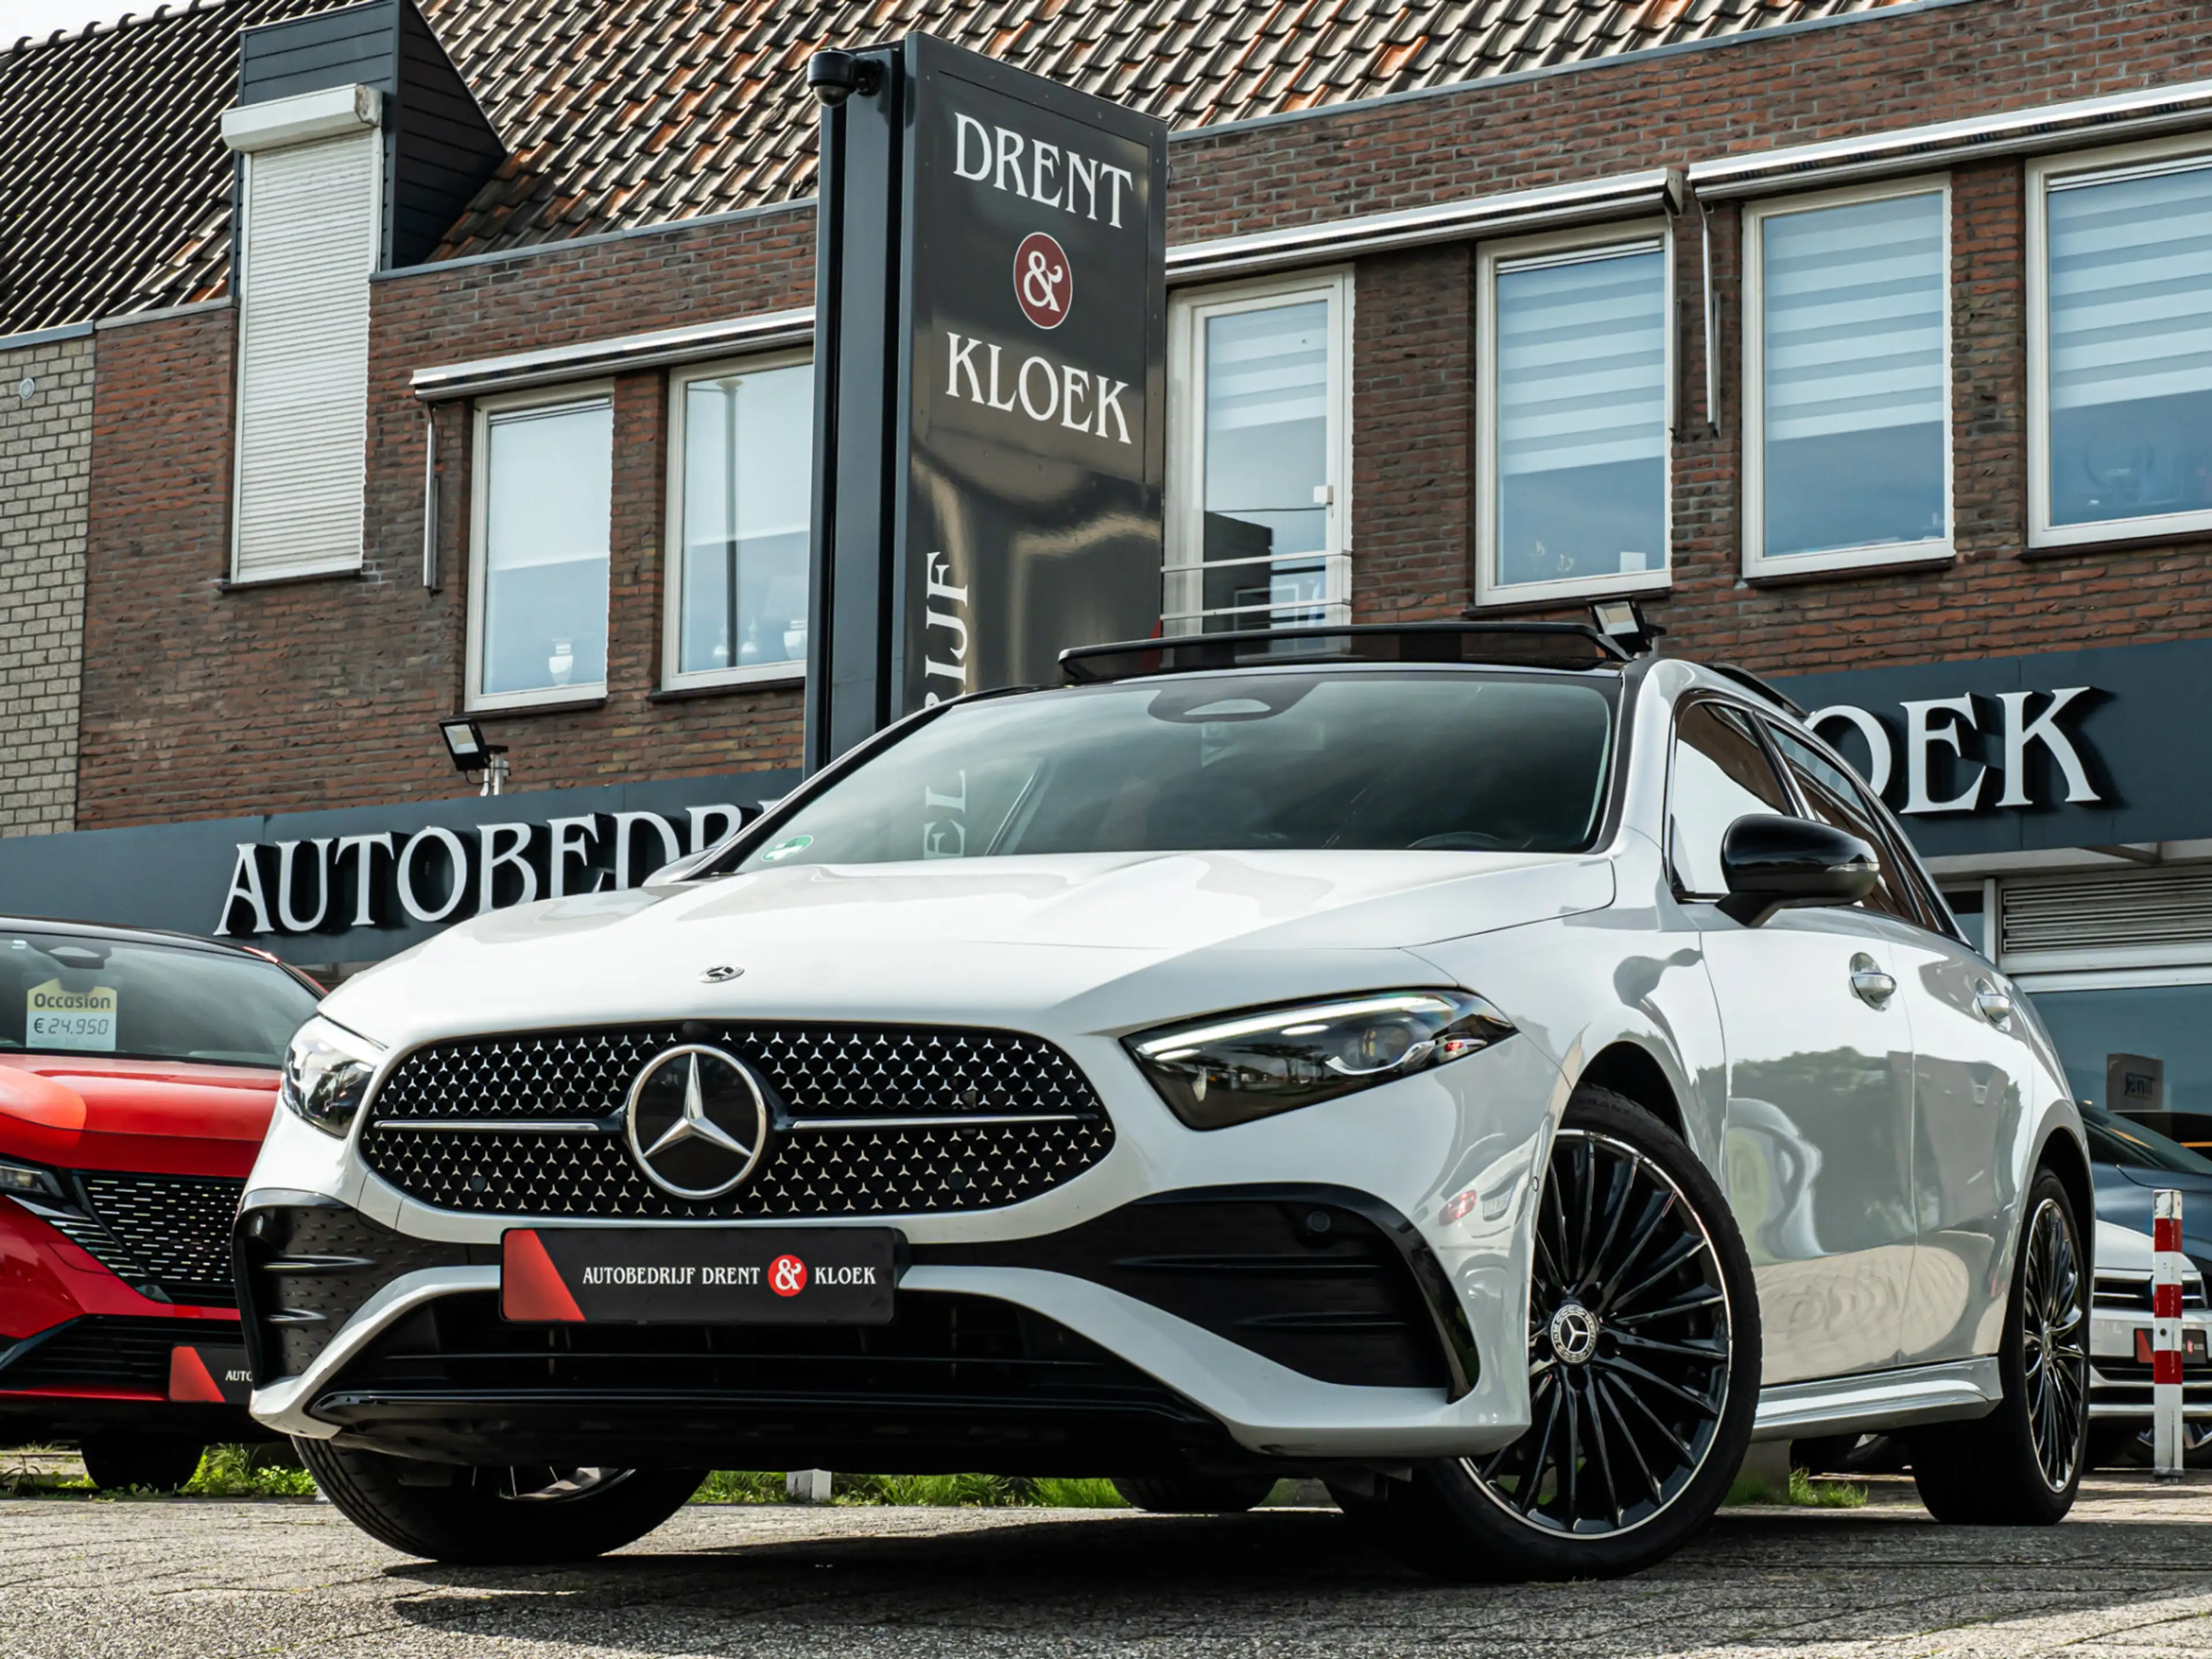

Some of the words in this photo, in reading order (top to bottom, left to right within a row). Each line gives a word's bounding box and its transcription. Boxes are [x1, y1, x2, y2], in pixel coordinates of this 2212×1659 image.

[953, 112, 1133, 229] DRENT
[1023, 251, 1063, 312] &
[946, 332, 1132, 444] KLOEK
[214, 798, 783, 936] AUTOBEDR
[34, 993, 111, 1009] Occasion
[34, 1018, 44, 1033] €
[48, 1018, 109, 1035] 24.950
[582, 1267, 696, 1285] AUTOBEDRIJF
[702, 1267, 760, 1285] DRENT
[775, 1259, 802, 1290] &
[815, 1267, 877, 1285] KLOEK
